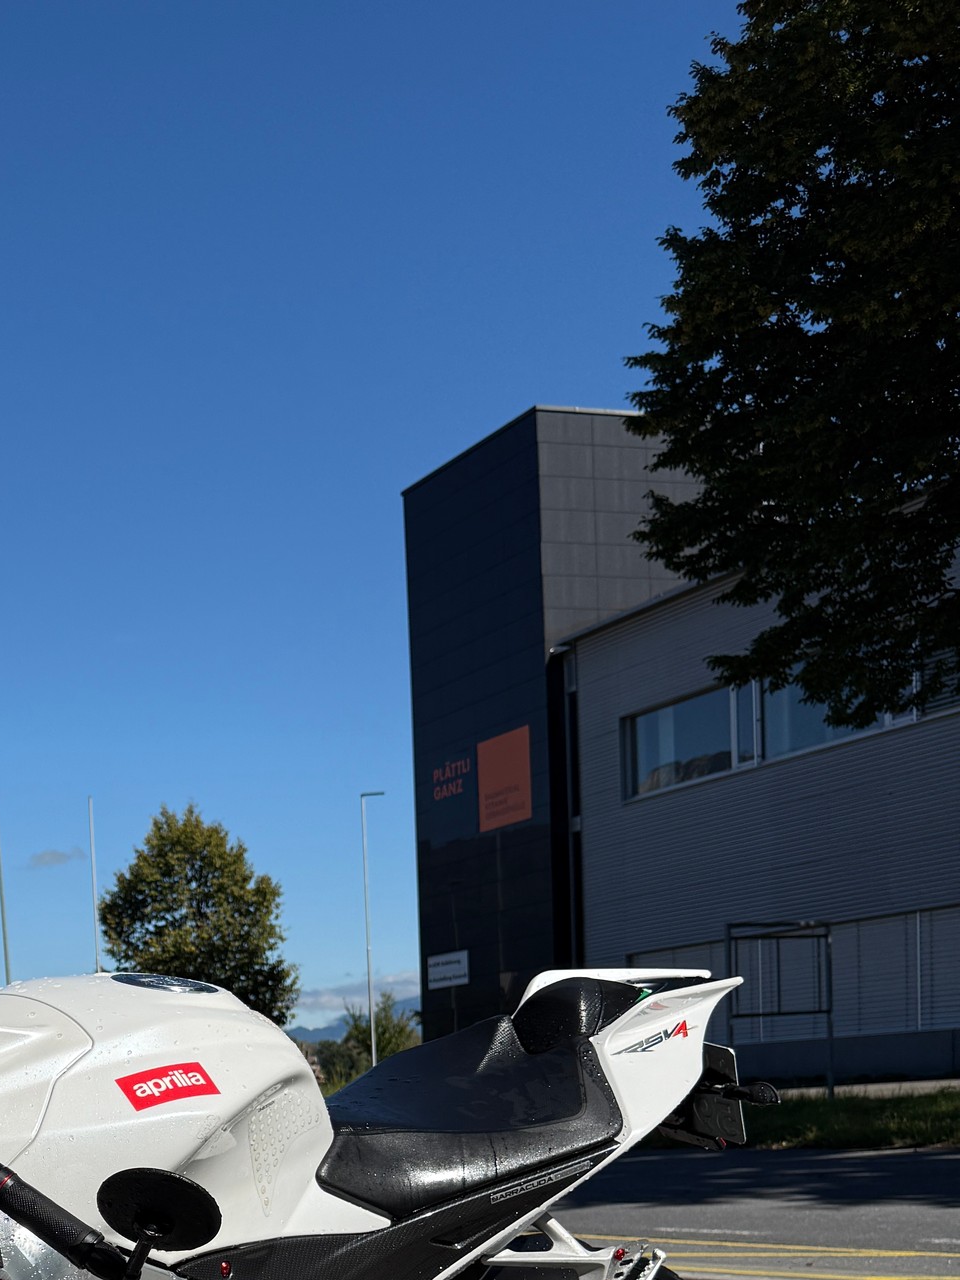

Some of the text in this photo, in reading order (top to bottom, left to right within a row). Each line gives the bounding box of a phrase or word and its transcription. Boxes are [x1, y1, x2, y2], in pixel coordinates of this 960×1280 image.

[433, 757, 470, 783] PLÄTTLI
[433, 778, 464, 801] GANZ
[610, 1019, 698, 1056] RSV4
[132, 1069, 207, 1098] aprilia
[491, 1175, 554, 1203] BARRACUDA
